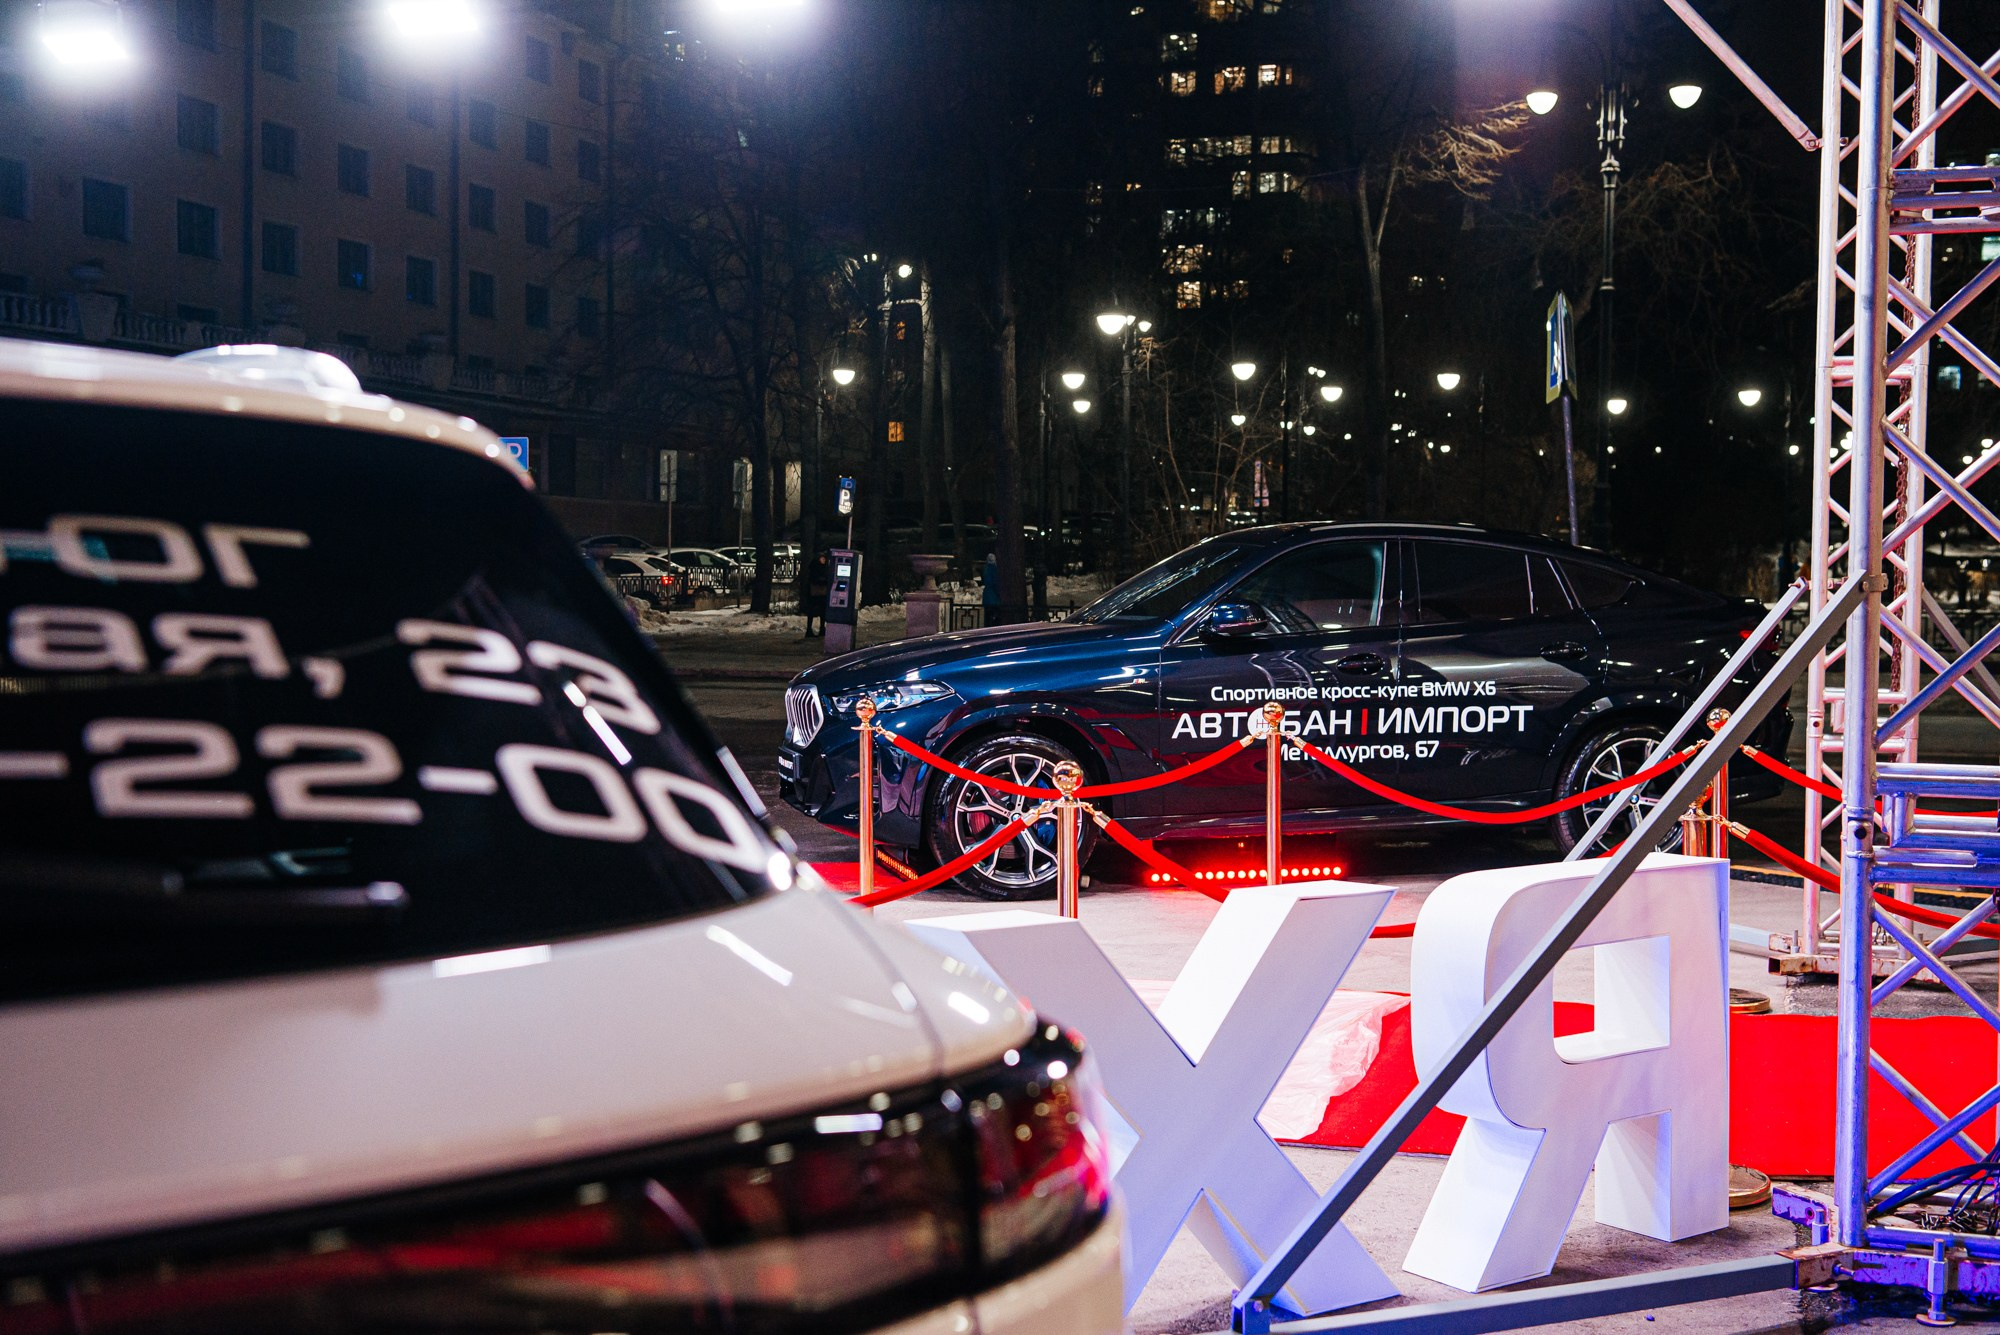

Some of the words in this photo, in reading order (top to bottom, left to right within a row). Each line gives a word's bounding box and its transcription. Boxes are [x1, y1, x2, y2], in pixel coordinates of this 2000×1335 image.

[397, 617, 661, 735] 23
[1210, 686, 1318, 703] Спортивное
[1321, 685, 1418, 701] кросс-купе
[1421, 681, 1470, 697] BMW
[1473, 680, 1497, 696] X6
[1377, 705, 1534, 735] ИМПОРТ
[1415, 740, 1440, 758] 67
